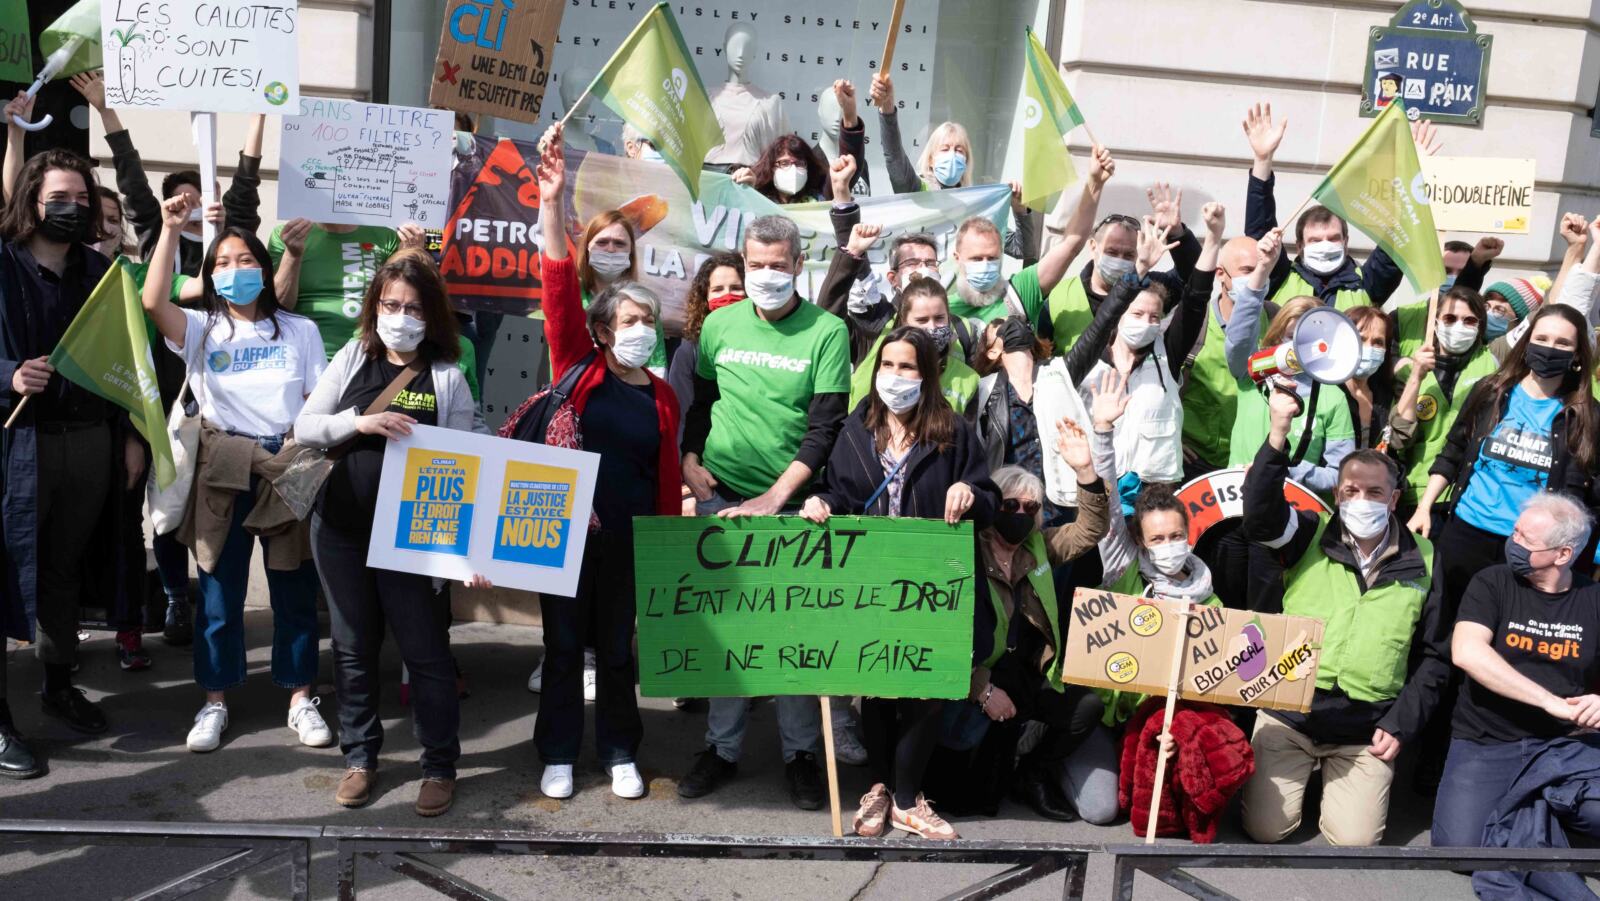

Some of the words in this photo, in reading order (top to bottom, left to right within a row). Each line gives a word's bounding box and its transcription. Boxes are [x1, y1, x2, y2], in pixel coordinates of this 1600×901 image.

[115, 0, 171, 26] LES
[195, 3, 296, 34] CALOTTES
[784, 15, 879, 30] SISLEY
[1412, 12, 1427, 24] 2e
[175, 35, 249, 57] SONT
[471, 54, 497, 75] UNE
[500, 60, 527, 82] DEMI
[530, 68, 549, 88] LOI
[1406, 52, 1450, 71] RUE
[156, 65, 263, 92] CUITES!
[459, 78, 478, 99] NE
[478, 81, 521, 107] SUFFIT
[520, 92, 543, 114] PAS
[1431, 82, 1474, 104] PAIX
[299, 100, 352, 120] SANS
[365, 106, 438, 129] FILTRE
[311, 123, 349, 142] 100
[359, 128, 422, 147] FILTRES
[342, 242, 363, 318] OXFAM
[234, 346, 287, 362] L'AFFAIRE
[234, 363, 249, 371] DU
[719, 346, 811, 372] GREENPEACE
[1490, 442, 1507, 456] EN
[1507, 446, 1553, 468] DANGER
[1506, 432, 1549, 452] CLIMAT
[416, 475, 464, 502] PLUS
[507, 491, 520, 505] LA
[523, 492, 567, 507] JUSTICE
[413, 503, 426, 518] LE
[427, 504, 461, 519] DROIT
[505, 506, 529, 515] EST
[532, 508, 565, 517] AVEC
[409, 531, 430, 544] RIEN
[432, 533, 458, 545] FAIRE
[411, 519, 433, 531] DE
[436, 520, 460, 531] NE
[501, 518, 562, 548] NOUS
[696, 525, 868, 570] CLIMAT
[646, 573, 731, 617] L'ÉTAT
[736, 588, 776, 612] N'A
[785, 586, 845, 610] PLUS
[854, 587, 886, 610] LE
[1075, 592, 1117, 626] NON
[1086, 619, 1126, 653] AUX
[1526, 626, 1543, 635] avec
[1545, 629, 1552, 637] le
[1550, 622, 1583, 633] négocie
[656, 648, 703, 675] DE
[725, 644, 764, 671] NE
[1192, 638, 1219, 664] AU
[1226, 642, 1264, 672] LOCAL
[1506, 633, 1533, 651] on
[1537, 640, 1580, 660] agit
[1240, 676, 1271, 702] POUR
[1268, 643, 1312, 681] TOUTES
